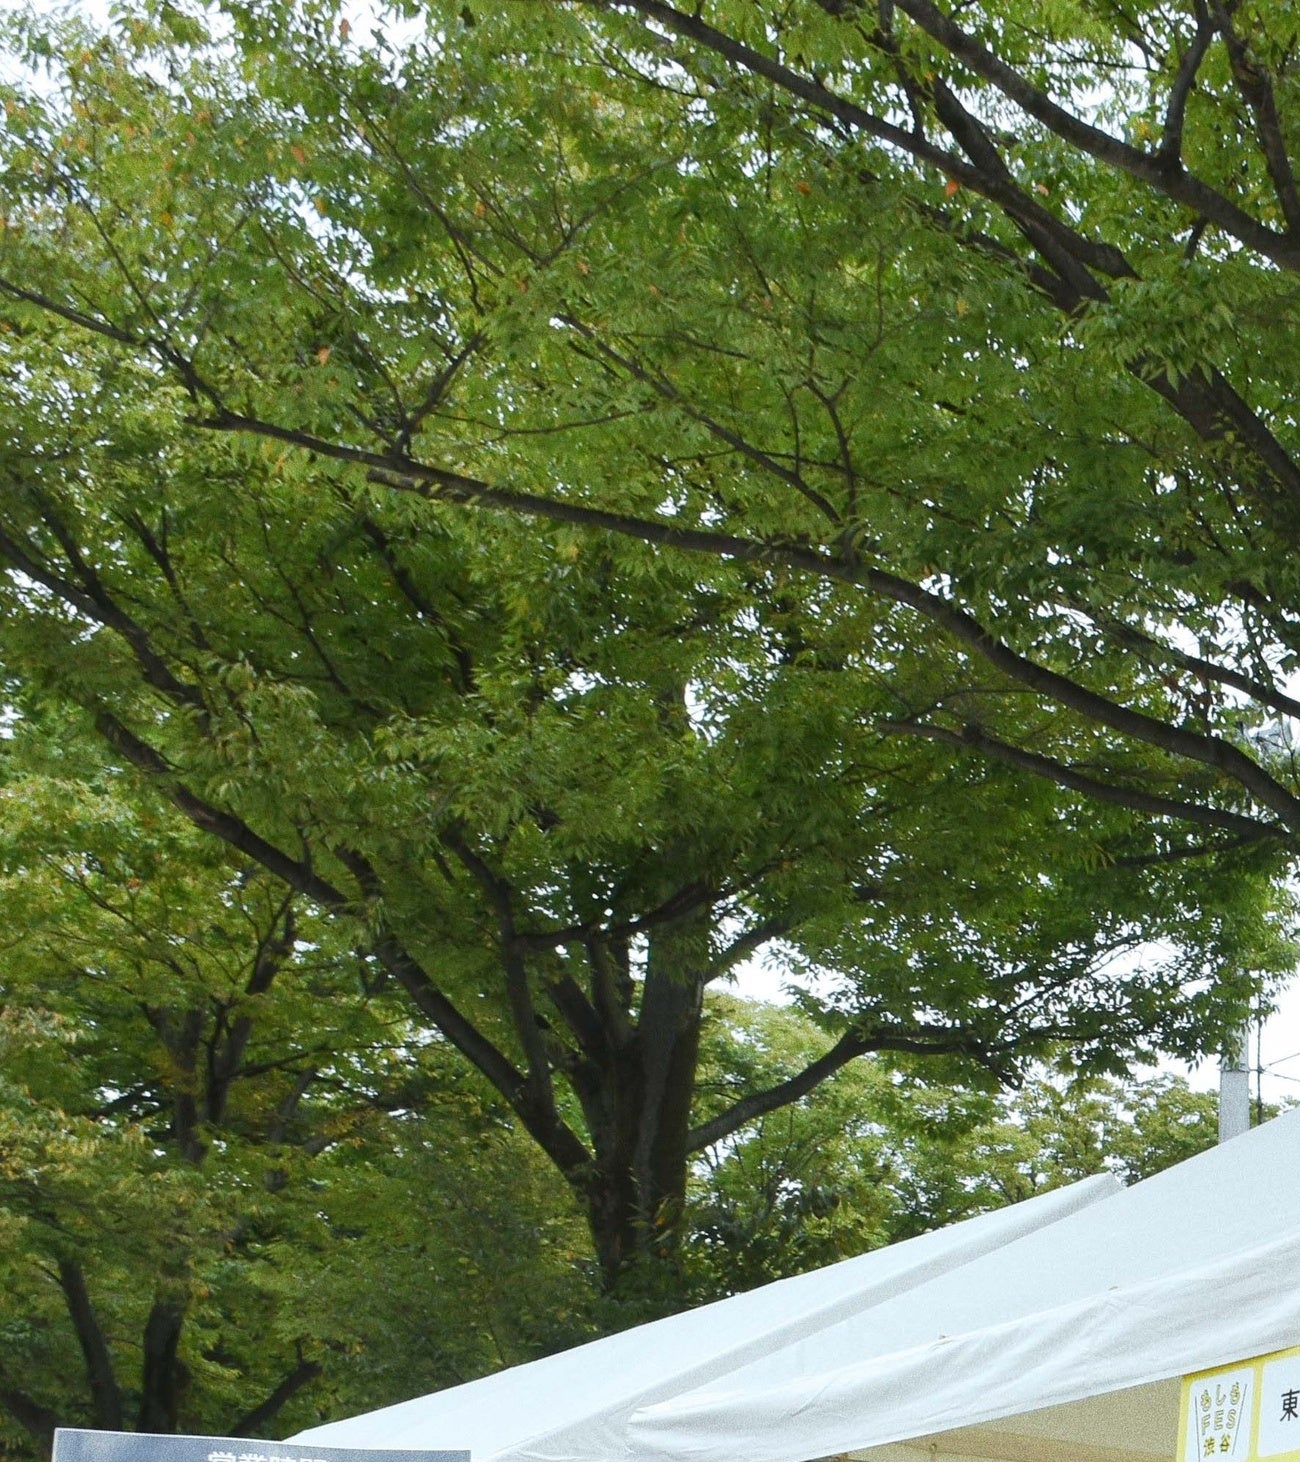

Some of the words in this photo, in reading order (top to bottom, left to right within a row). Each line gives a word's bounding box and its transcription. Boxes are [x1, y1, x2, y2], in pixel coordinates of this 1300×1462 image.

[1200, 1382, 1241, 1412] もしも
[1201, 1408, 1237, 1435] FES
[1203, 1434, 1231, 1457] 渋谷
